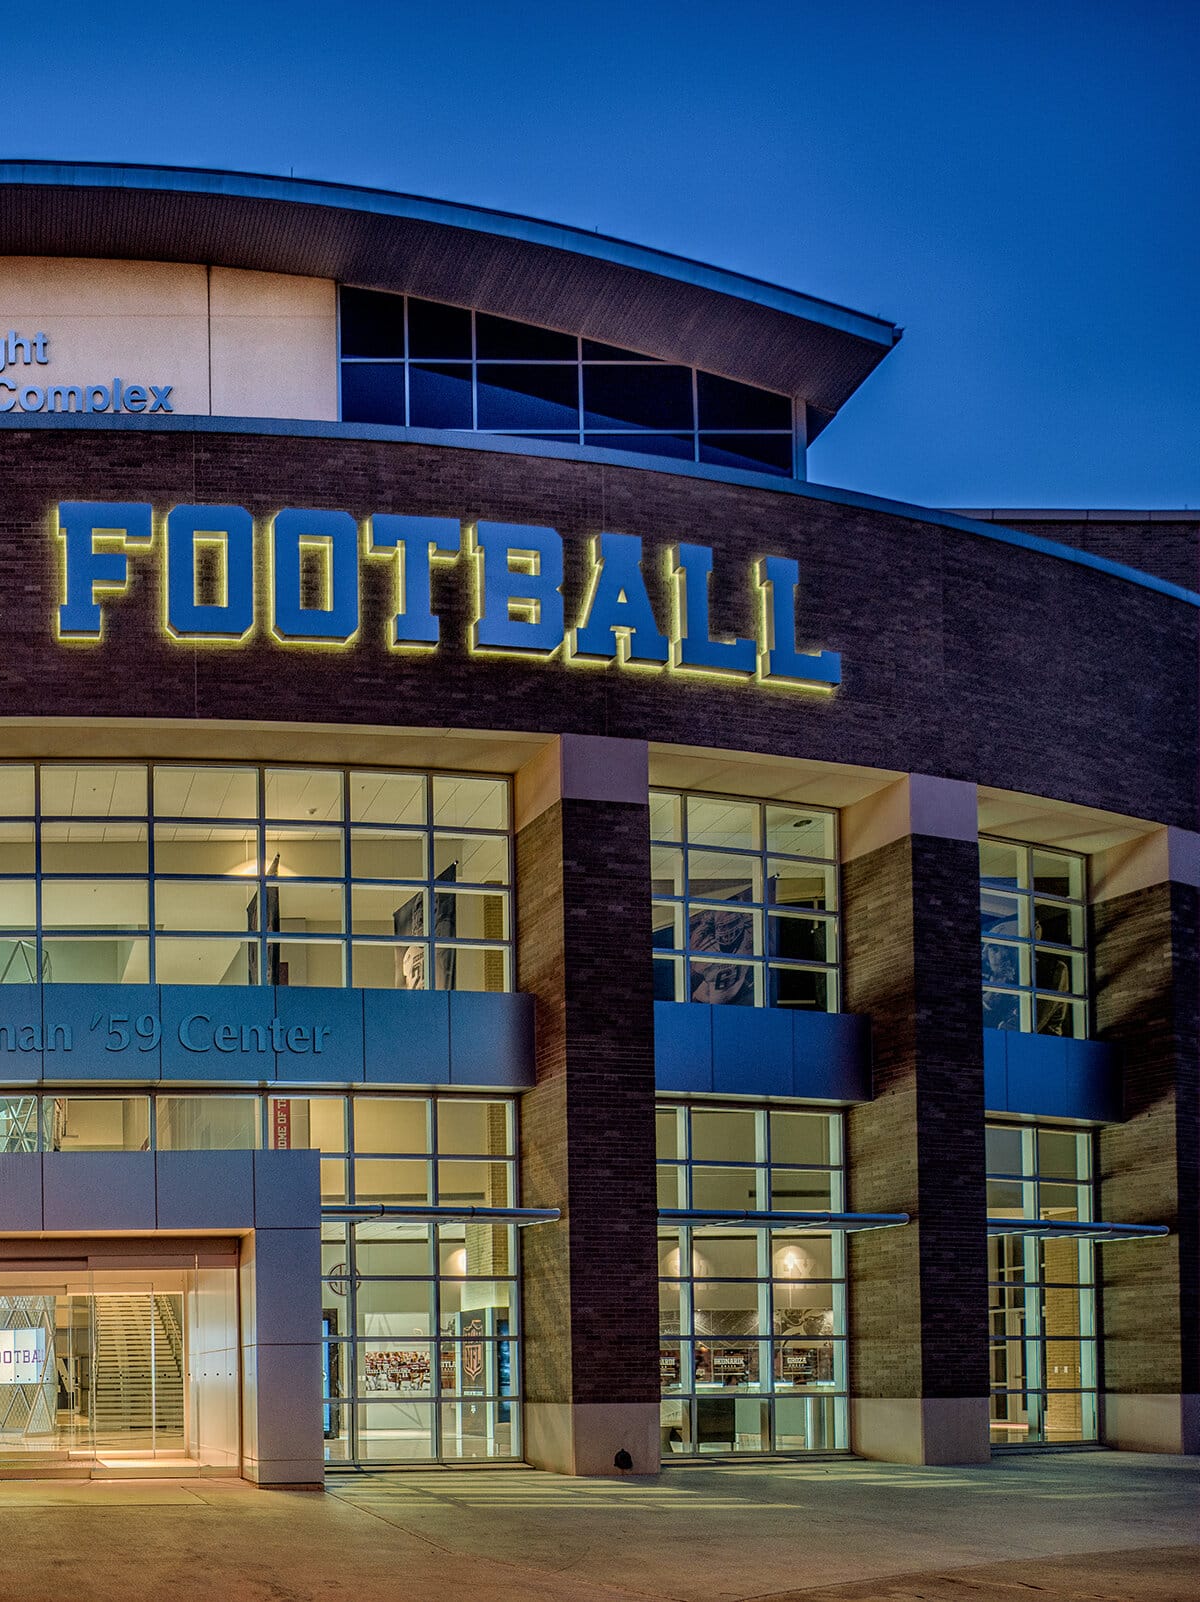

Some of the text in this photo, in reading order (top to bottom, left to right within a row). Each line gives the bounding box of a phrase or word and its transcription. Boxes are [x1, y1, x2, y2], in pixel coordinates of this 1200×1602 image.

[56, 500, 842, 692] FOOTBALL
[89, 1013, 163, 1052] '59
[178, 1014, 331, 1054] Center
